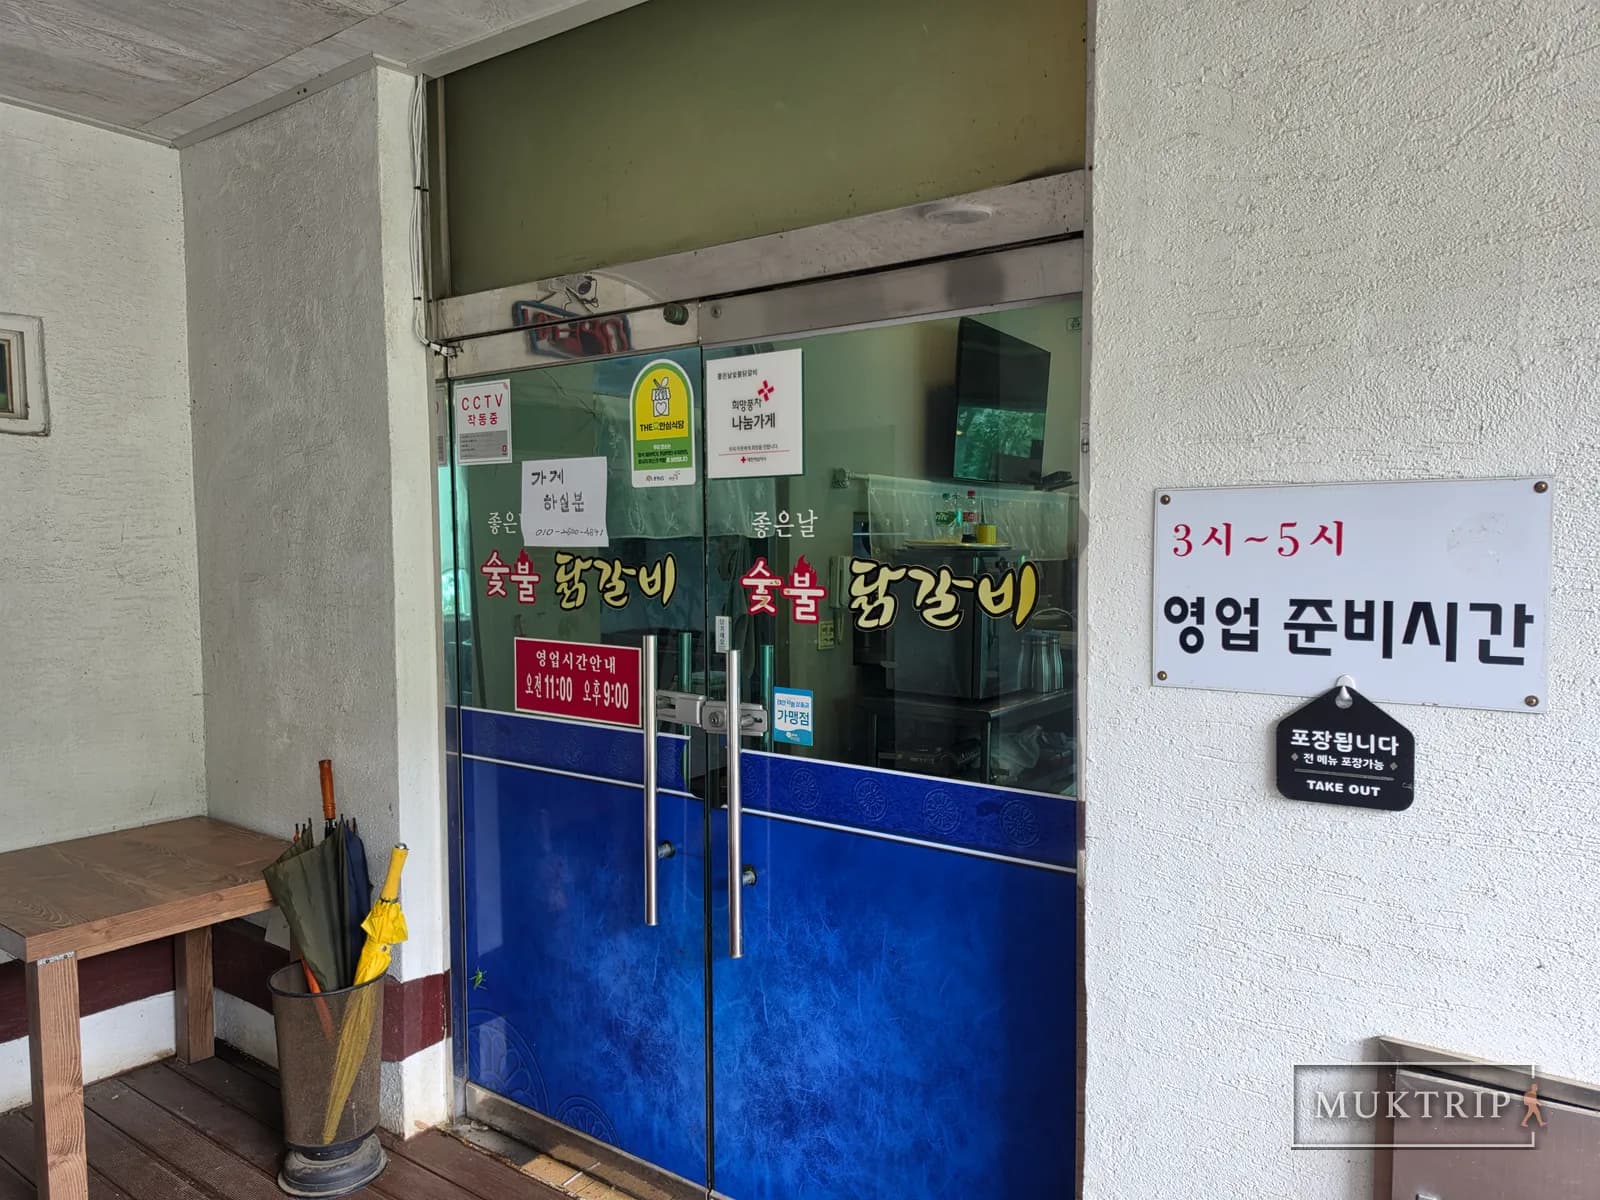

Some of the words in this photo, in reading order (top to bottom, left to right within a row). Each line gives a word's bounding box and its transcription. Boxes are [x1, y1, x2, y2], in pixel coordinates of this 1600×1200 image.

[461, 393, 503, 411] CCTV
[731, 398, 762, 412] 희망풍차
[468, 412, 498, 426] 작동중
[732, 412, 776, 431] 나눔가게
[531, 468, 564, 485] 가게
[487, 512, 521, 535] 좋은
[752, 509, 818, 539] 좋은날
[481, 549, 541, 604] 숯불
[554, 551, 677, 610] 닭갈비
[740, 557, 828, 626] 숯불
[849, 557, 1041, 632] 닭갈비
[1163, 595, 1260, 655] 영업
[1284, 598, 1534, 666] 준비시간
[777, 709, 810, 726] 가맹점
[1290, 727, 1400, 757] 포장됩니다
[1303, 752, 1315, 766] 전
[1316, 753, 1338, 768] 메뉴
[1341, 755, 1385, 771] 포장가능
[1306, 779, 1344, 793] TAKE
[1348, 783, 1381, 797] OUT
